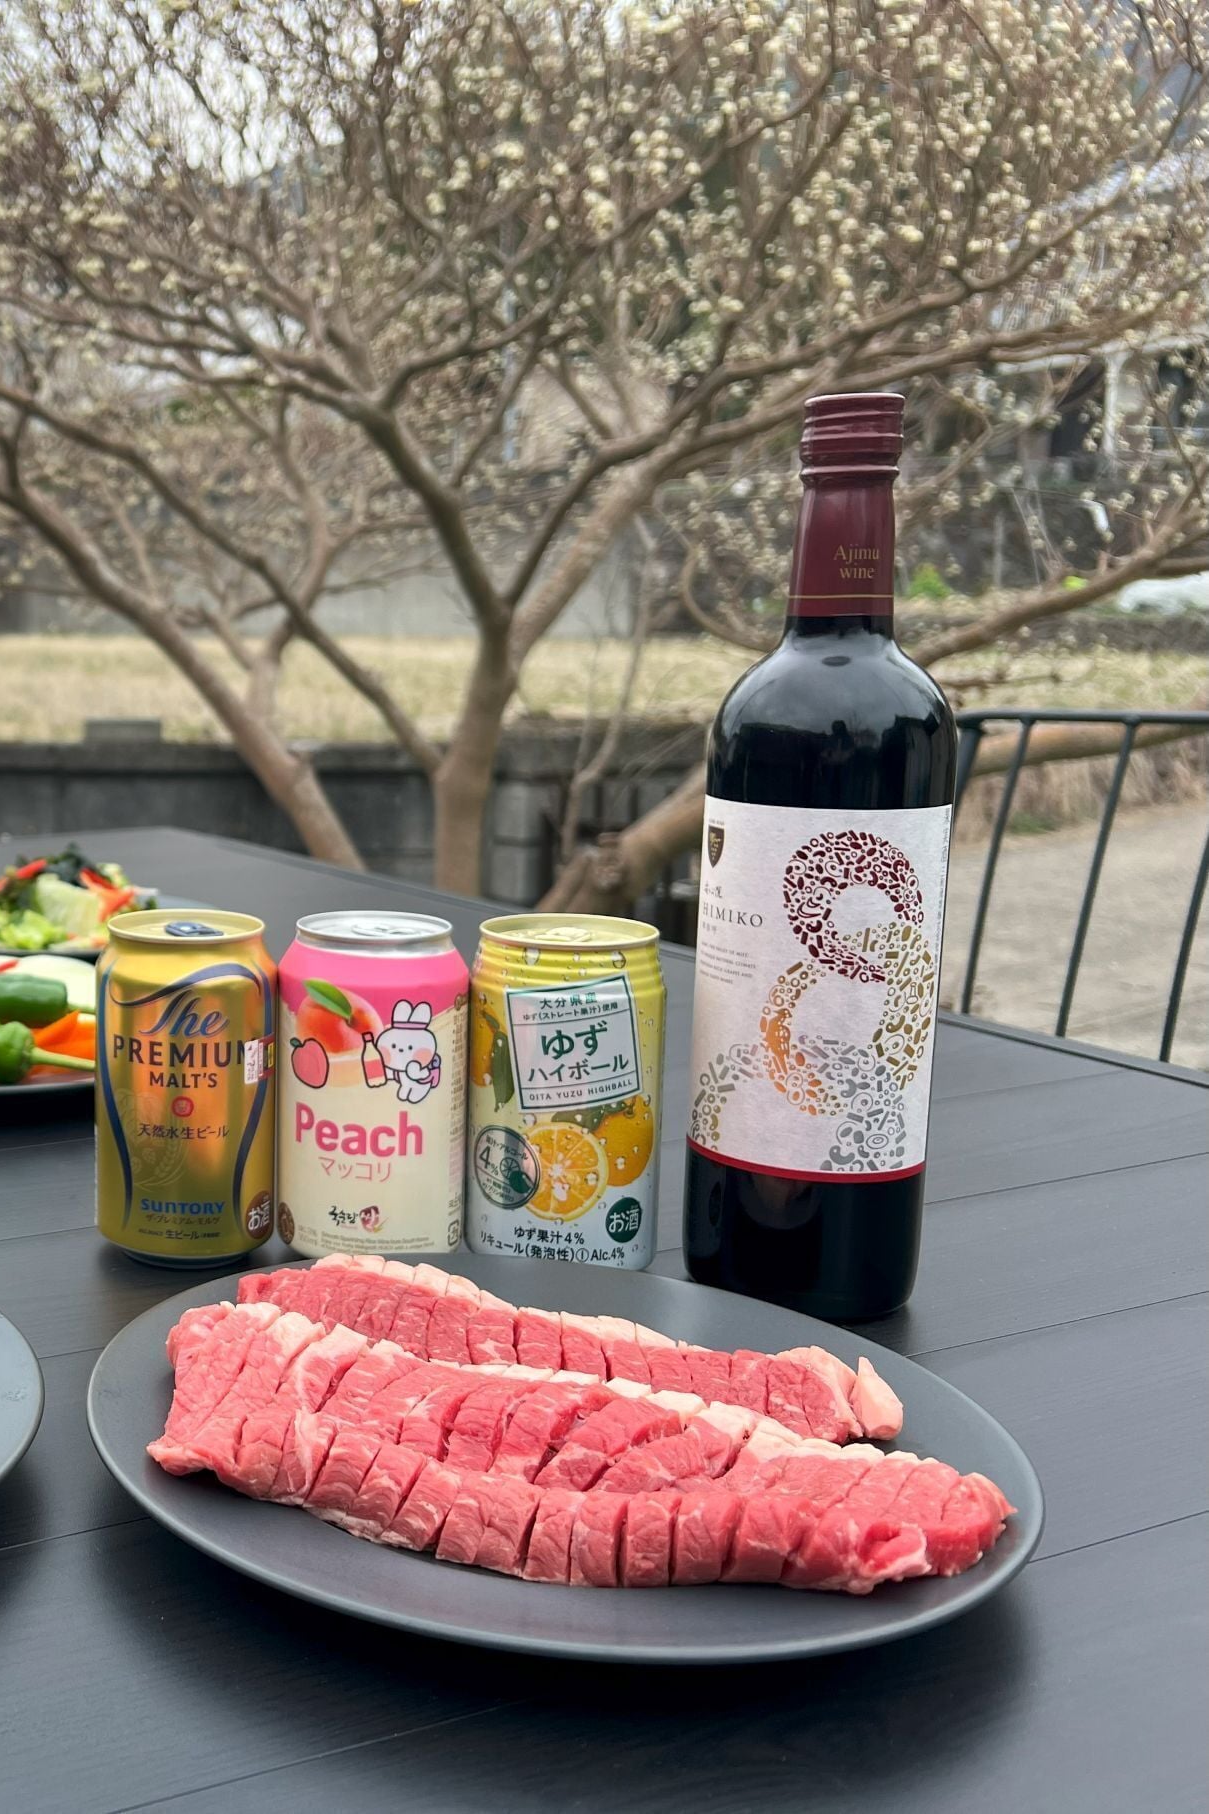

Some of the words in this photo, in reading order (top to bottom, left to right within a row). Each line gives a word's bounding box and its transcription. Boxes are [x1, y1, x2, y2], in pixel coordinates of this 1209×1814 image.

[833, 544, 879, 565] Ajimu
[839, 562, 875, 579] wine
[703, 902, 763, 928] HIMIKO
[539, 991, 598, 1010] 大分県産
[139, 988, 230, 1038] The
[540, 1019, 609, 1060] ゆず
[149, 1071, 218, 1089] MALT'S
[528, 1053, 630, 1083] ハイボール
[529, 1093, 553, 1101] OITA
[556, 1089, 583, 1099] YUZU
[587, 1079, 633, 1096] HIGHBALL
[137, 1122, 230, 1140] 天然水生ビール
[295, 1101, 423, 1157] Peach
[317, 1156, 392, 1183] マッコリ
[608, 1209, 640, 1233] お酒
